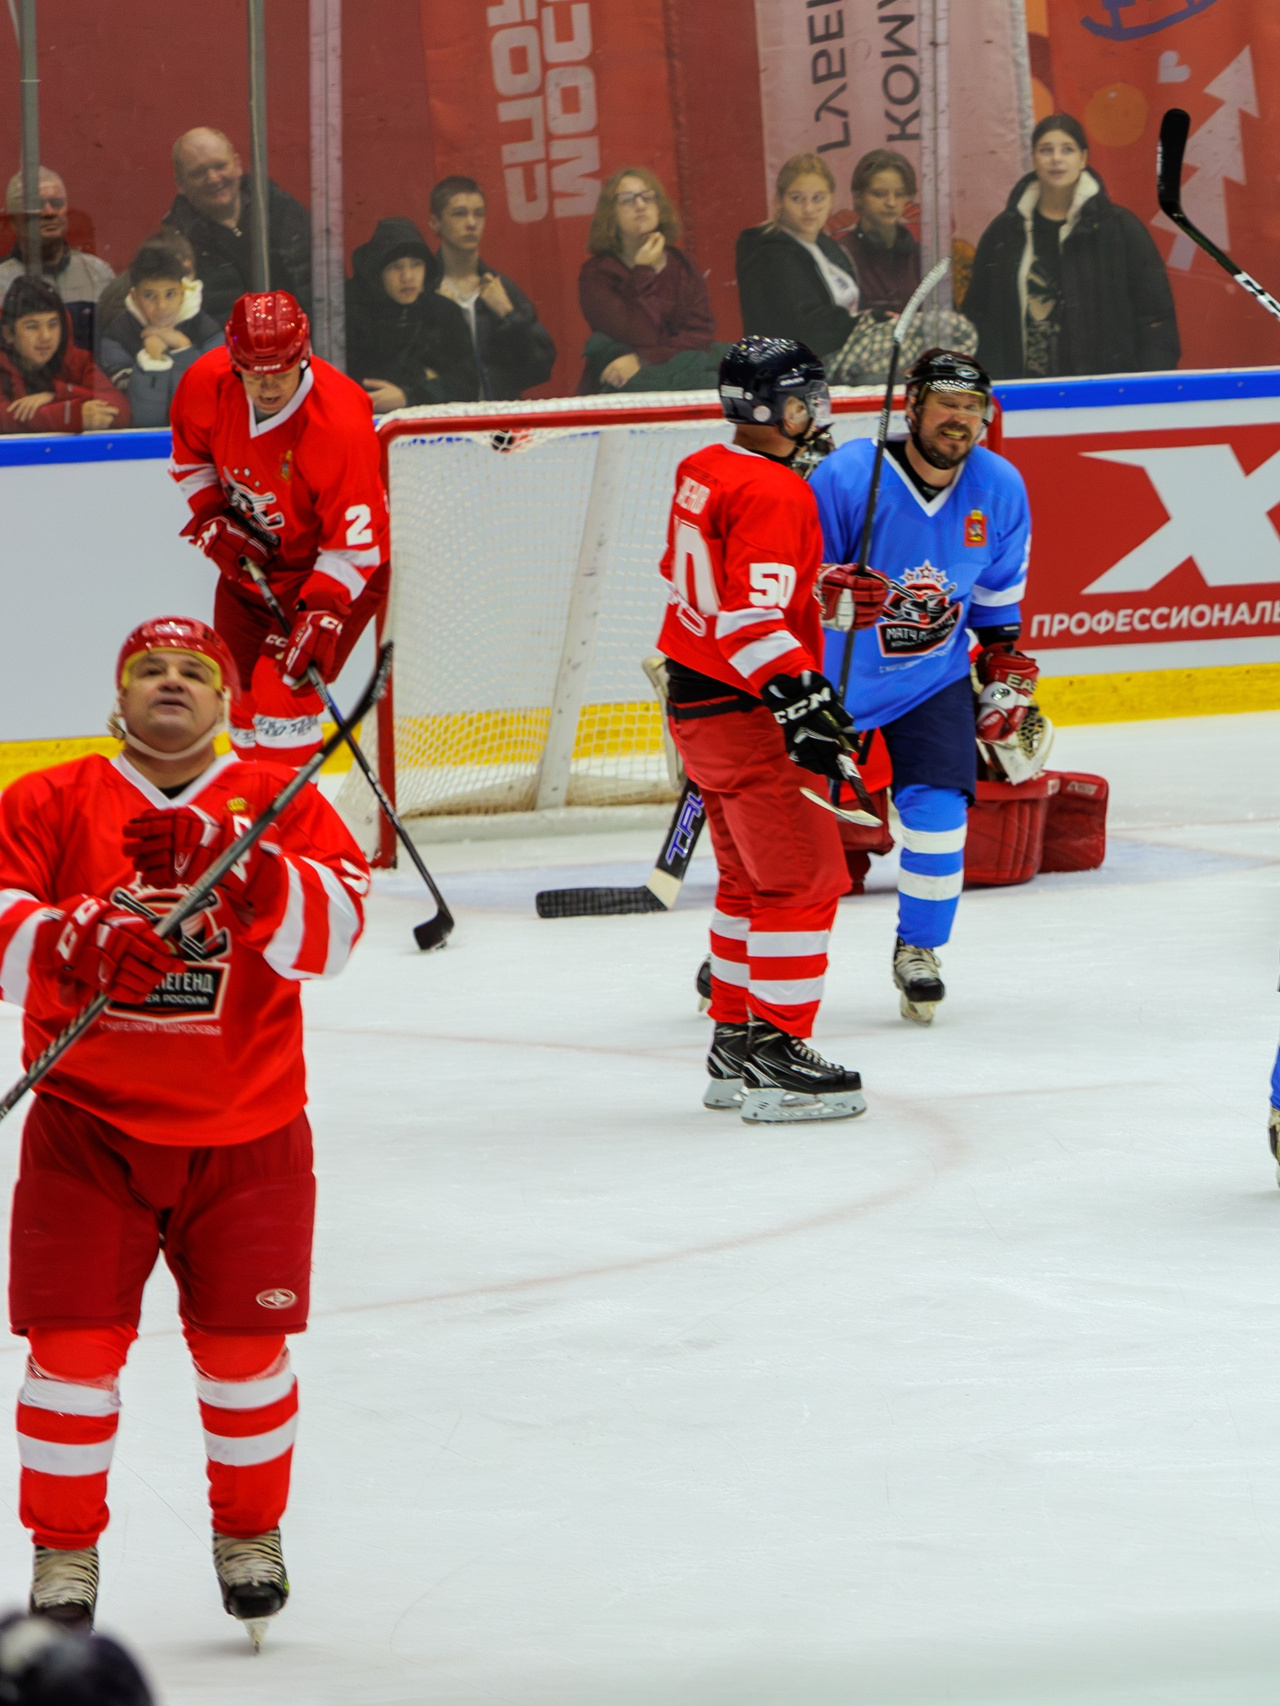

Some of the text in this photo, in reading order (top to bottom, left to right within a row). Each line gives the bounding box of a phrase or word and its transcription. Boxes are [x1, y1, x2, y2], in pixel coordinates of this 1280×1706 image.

[345, 504, 373, 546] 2
[749, 562, 797, 608] 50
[773, 686, 831, 724] CCM
